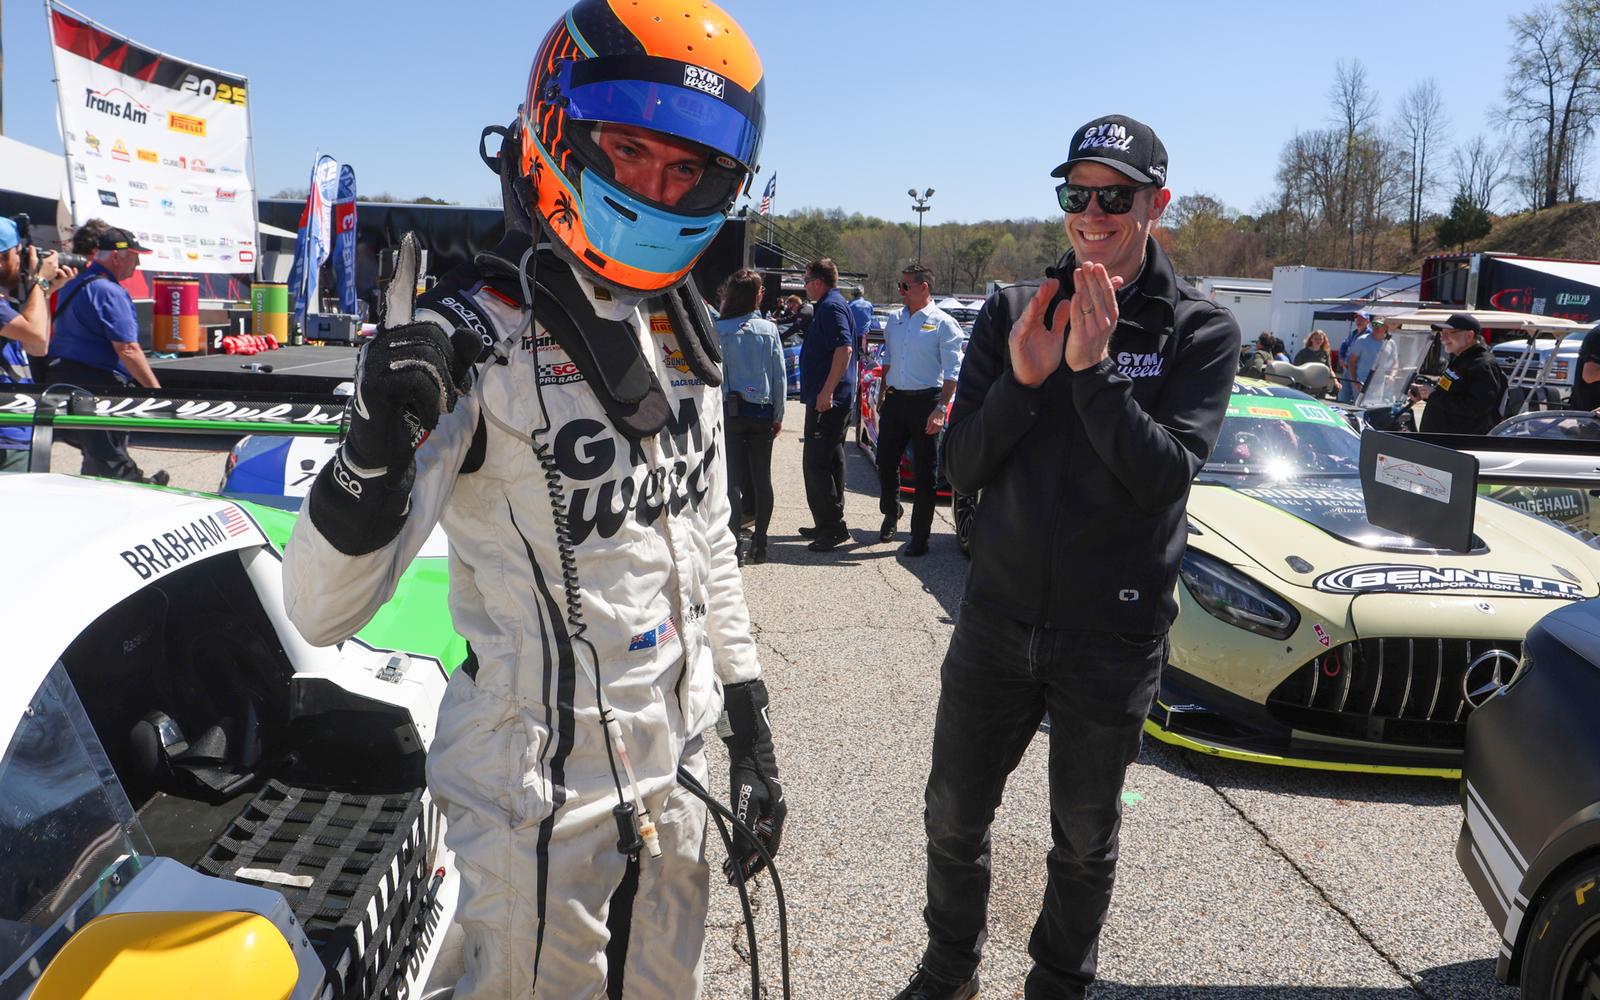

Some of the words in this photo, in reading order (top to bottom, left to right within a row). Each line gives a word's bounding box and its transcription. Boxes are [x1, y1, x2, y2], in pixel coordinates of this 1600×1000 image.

[686, 66, 718, 84] GYM
[181, 74, 246, 108] 2025
[686, 76, 723, 97] weed
[86, 88, 121, 117] Trans
[123, 102, 147, 124] Am
[170, 115, 203, 134] PIRELLI
[1084, 124, 1126, 139] GYM
[1078, 135, 1134, 151] weed
[239, 318, 245, 336] 1
[441, 297, 493, 347] sparco
[214, 330, 223, 349] 2
[521, 335, 558, 350] Tran
[1117, 351, 1158, 366] GYM
[1117, 358, 1164, 377] weed
[552, 363, 577, 377] SC
[539, 376, 557, 384] PRO
[689, 377, 706, 386] FUEL
[553, 397, 703, 481] GM
[120, 515, 228, 580] BRABHAM
[1350, 568, 1579, 593] BENNETT
[1395, 582, 1512, 591] TRANSPORTATION
[738, 784, 752, 824] sparc
